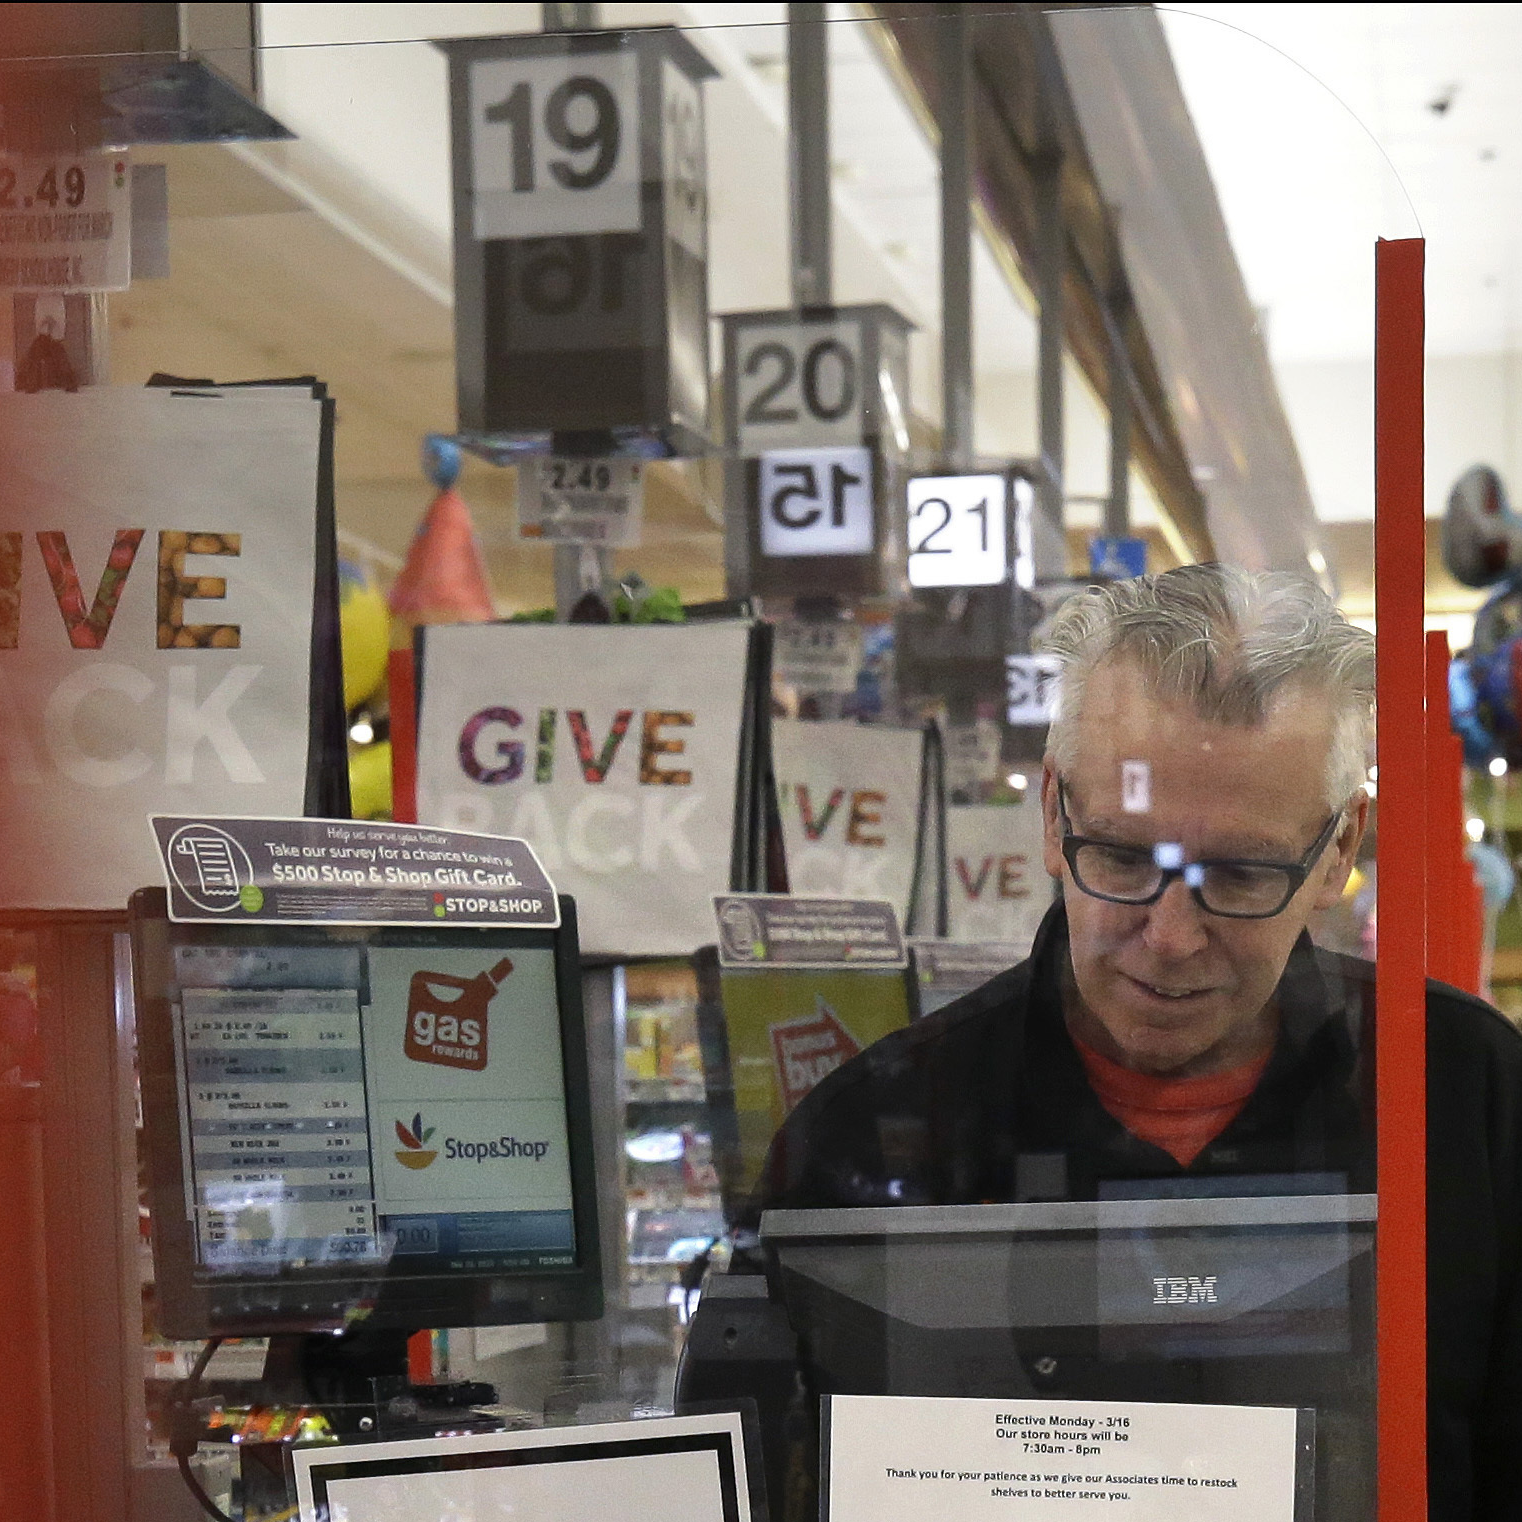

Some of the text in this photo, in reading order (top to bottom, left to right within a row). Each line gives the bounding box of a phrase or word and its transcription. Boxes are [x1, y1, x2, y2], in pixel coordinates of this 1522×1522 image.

[484, 74, 620, 193] 19
[742, 338, 859, 425] 20
[908, 496, 990, 555] 21
[457, 706, 696, 785] GIVE
[264, 842, 300, 857] Take
[302, 847, 327, 857] our
[328, 848, 376, 862] survey
[377, 845, 399, 859] for
[401, 850, 412, 860] a
[412, 849, 462, 862] chance
[462, 852, 478, 863] to
[477, 854, 503, 866] win
[272, 862, 319, 884] $500
[320, 865, 365, 887] Stop
[368, 866, 383, 882] &
[384, 866, 432, 887] Shop
[434, 868, 471, 885] Gift
[446, 898, 542, 914] STOP&SHOP
[413, 1010, 482, 1047] gas
[445, 1136, 549, 1163] Stop&Shop
[1153, 1277, 1218, 1305] IBM
[995, 1413, 1046, 1426] Effective
[1049, 1415, 1095, 1429] Monday
[1106, 1416, 1130, 1428] 3/16
[996, 1428, 1129, 1442] Our store hours will be
[1023, 1443, 1065, 1454] 7:30am
[1076, 1444, 1102, 1456] 8pm
[886, 1468, 1238, 1489] Thank you for your patience as we give our Associates time to restock
[991, 1487, 1131, 1502] shelves to better serve you.
